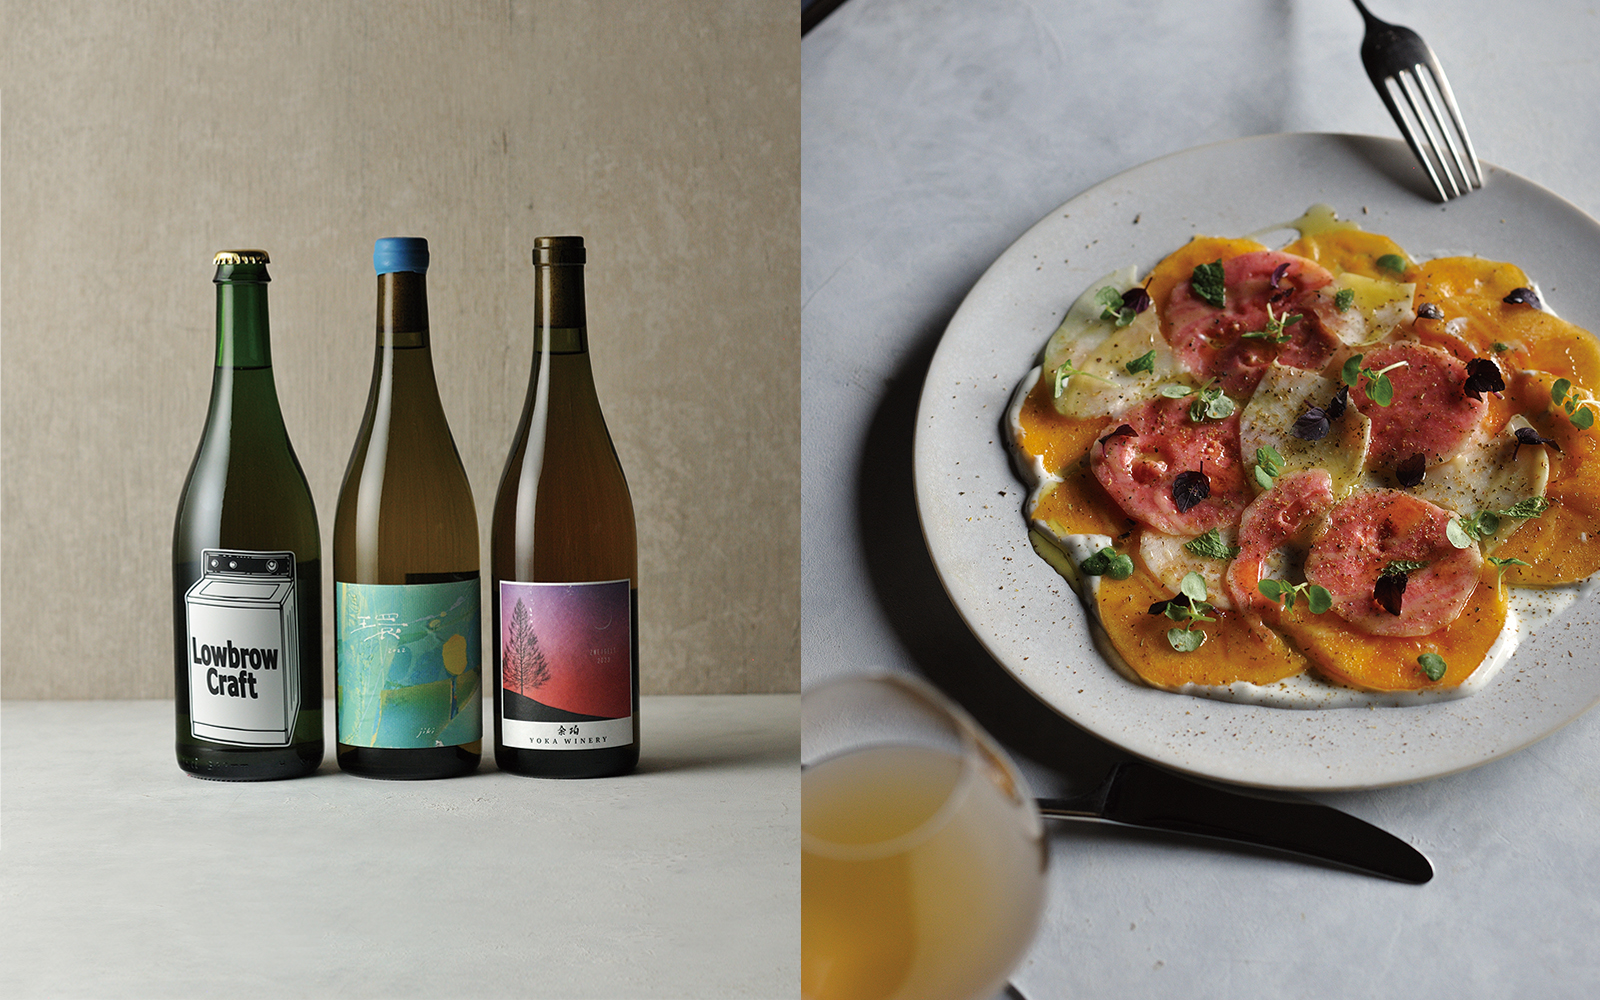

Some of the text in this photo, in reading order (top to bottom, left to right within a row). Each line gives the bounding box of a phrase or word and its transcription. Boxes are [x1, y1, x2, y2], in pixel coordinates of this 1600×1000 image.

[192, 636, 279, 670] Lowbrow
[206, 668, 259, 700] Craft
[529, 736, 608, 745] YOKA WINERY
